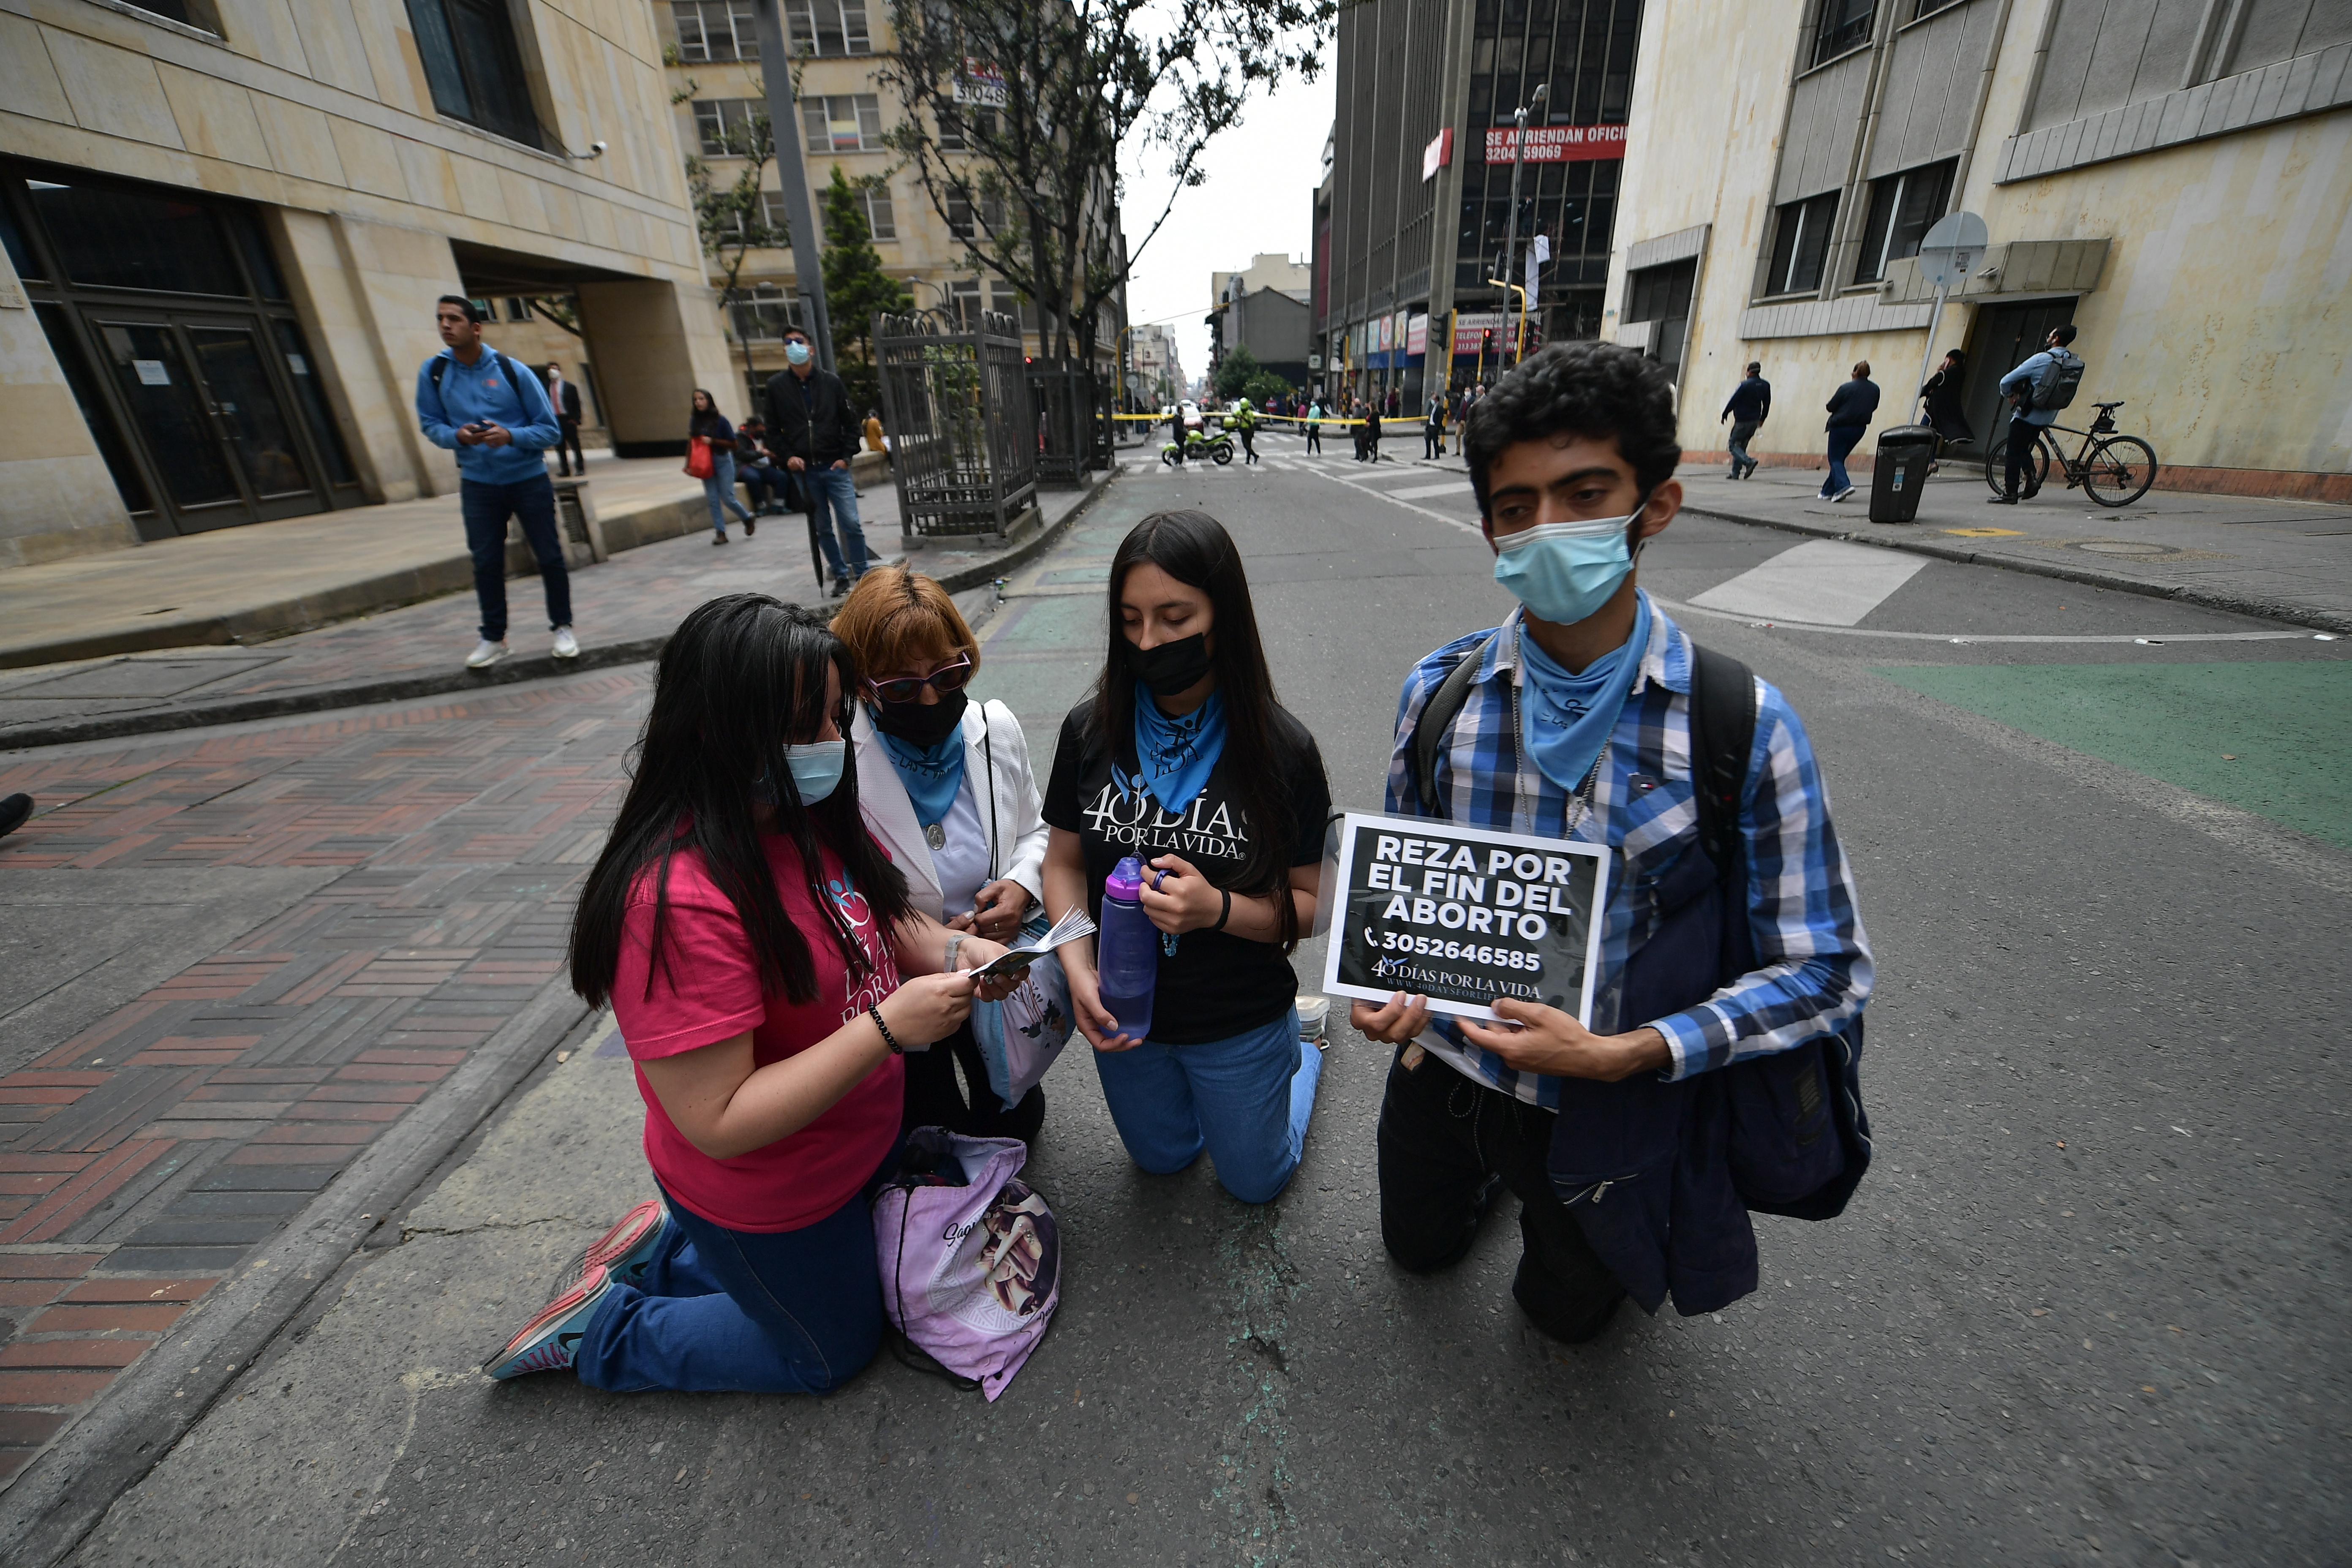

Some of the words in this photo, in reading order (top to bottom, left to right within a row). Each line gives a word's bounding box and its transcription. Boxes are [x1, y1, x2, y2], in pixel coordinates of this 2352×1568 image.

[1486, 131, 1502, 146] SE
[1486, 145, 1561, 161] 320459069
[1083, 782, 1146, 831] 40
[1103, 825, 1149, 846] POR
[1152, 829, 1181, 850] LA
[1376, 835, 1477, 873] REZA
[1488, 849, 1571, 885] POR
[1367, 863, 1411, 893] EL
[1422, 870, 1486, 903] FIN
[1494, 880, 1571, 915] DEL
[1382, 895, 1547, 941] ABORTO
[1381, 931, 1540, 972] 3052646585
[1371, 959, 1396, 977] 40
[1398, 964, 1436, 983] DÍAS
[1439, 971, 1473, 988] POR
[1473, 977, 1495, 992] LA
